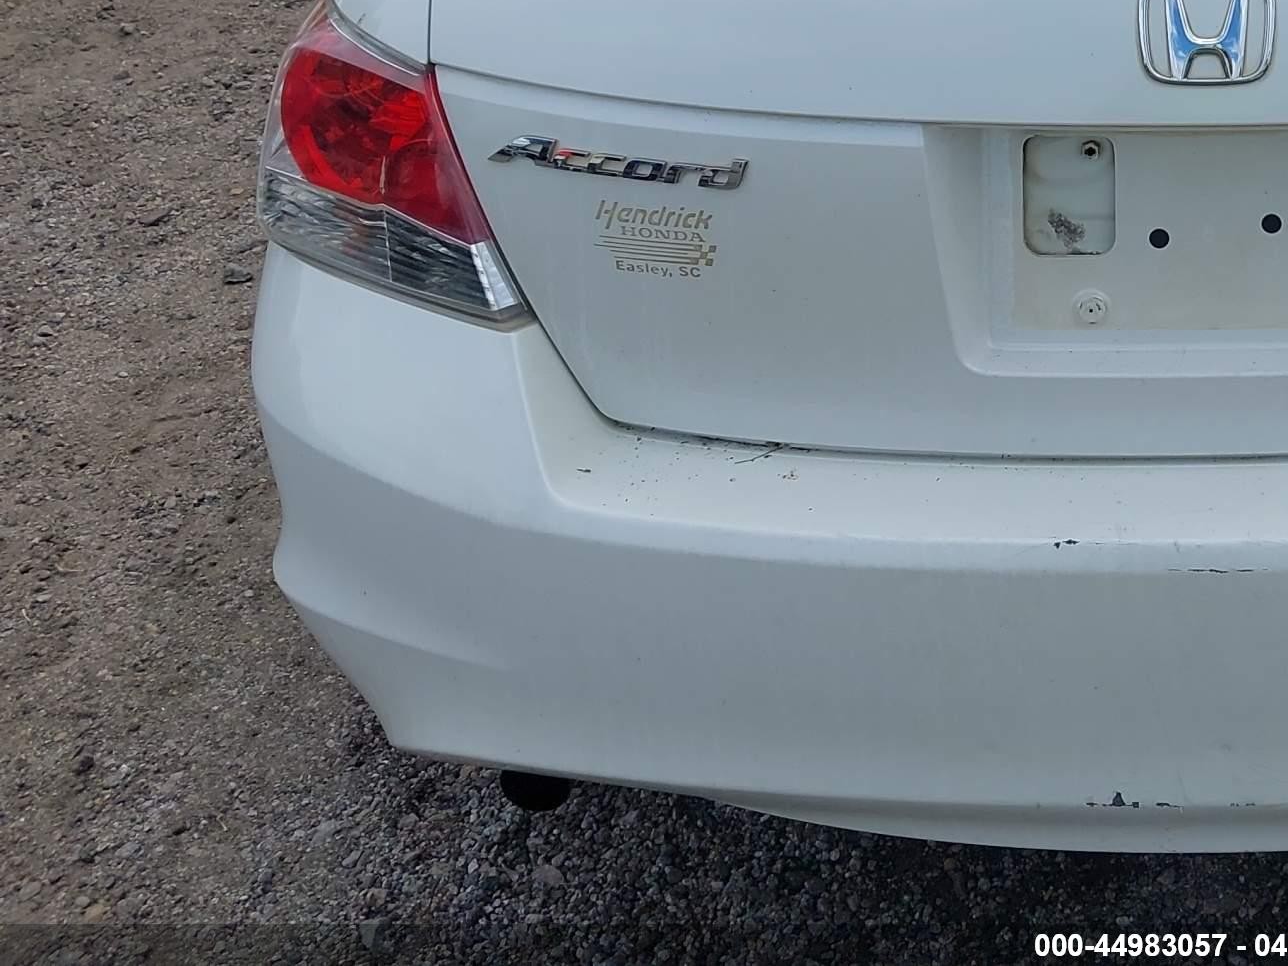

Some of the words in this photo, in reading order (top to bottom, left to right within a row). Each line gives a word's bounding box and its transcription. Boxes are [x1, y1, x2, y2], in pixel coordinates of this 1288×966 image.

[487, 134, 749, 190] Accord
[595, 199, 713, 230] Hendrick
[620, 226, 706, 242] HONDA
[615, 260, 673, 278] Easley,
[678, 266, 701, 278] SC
